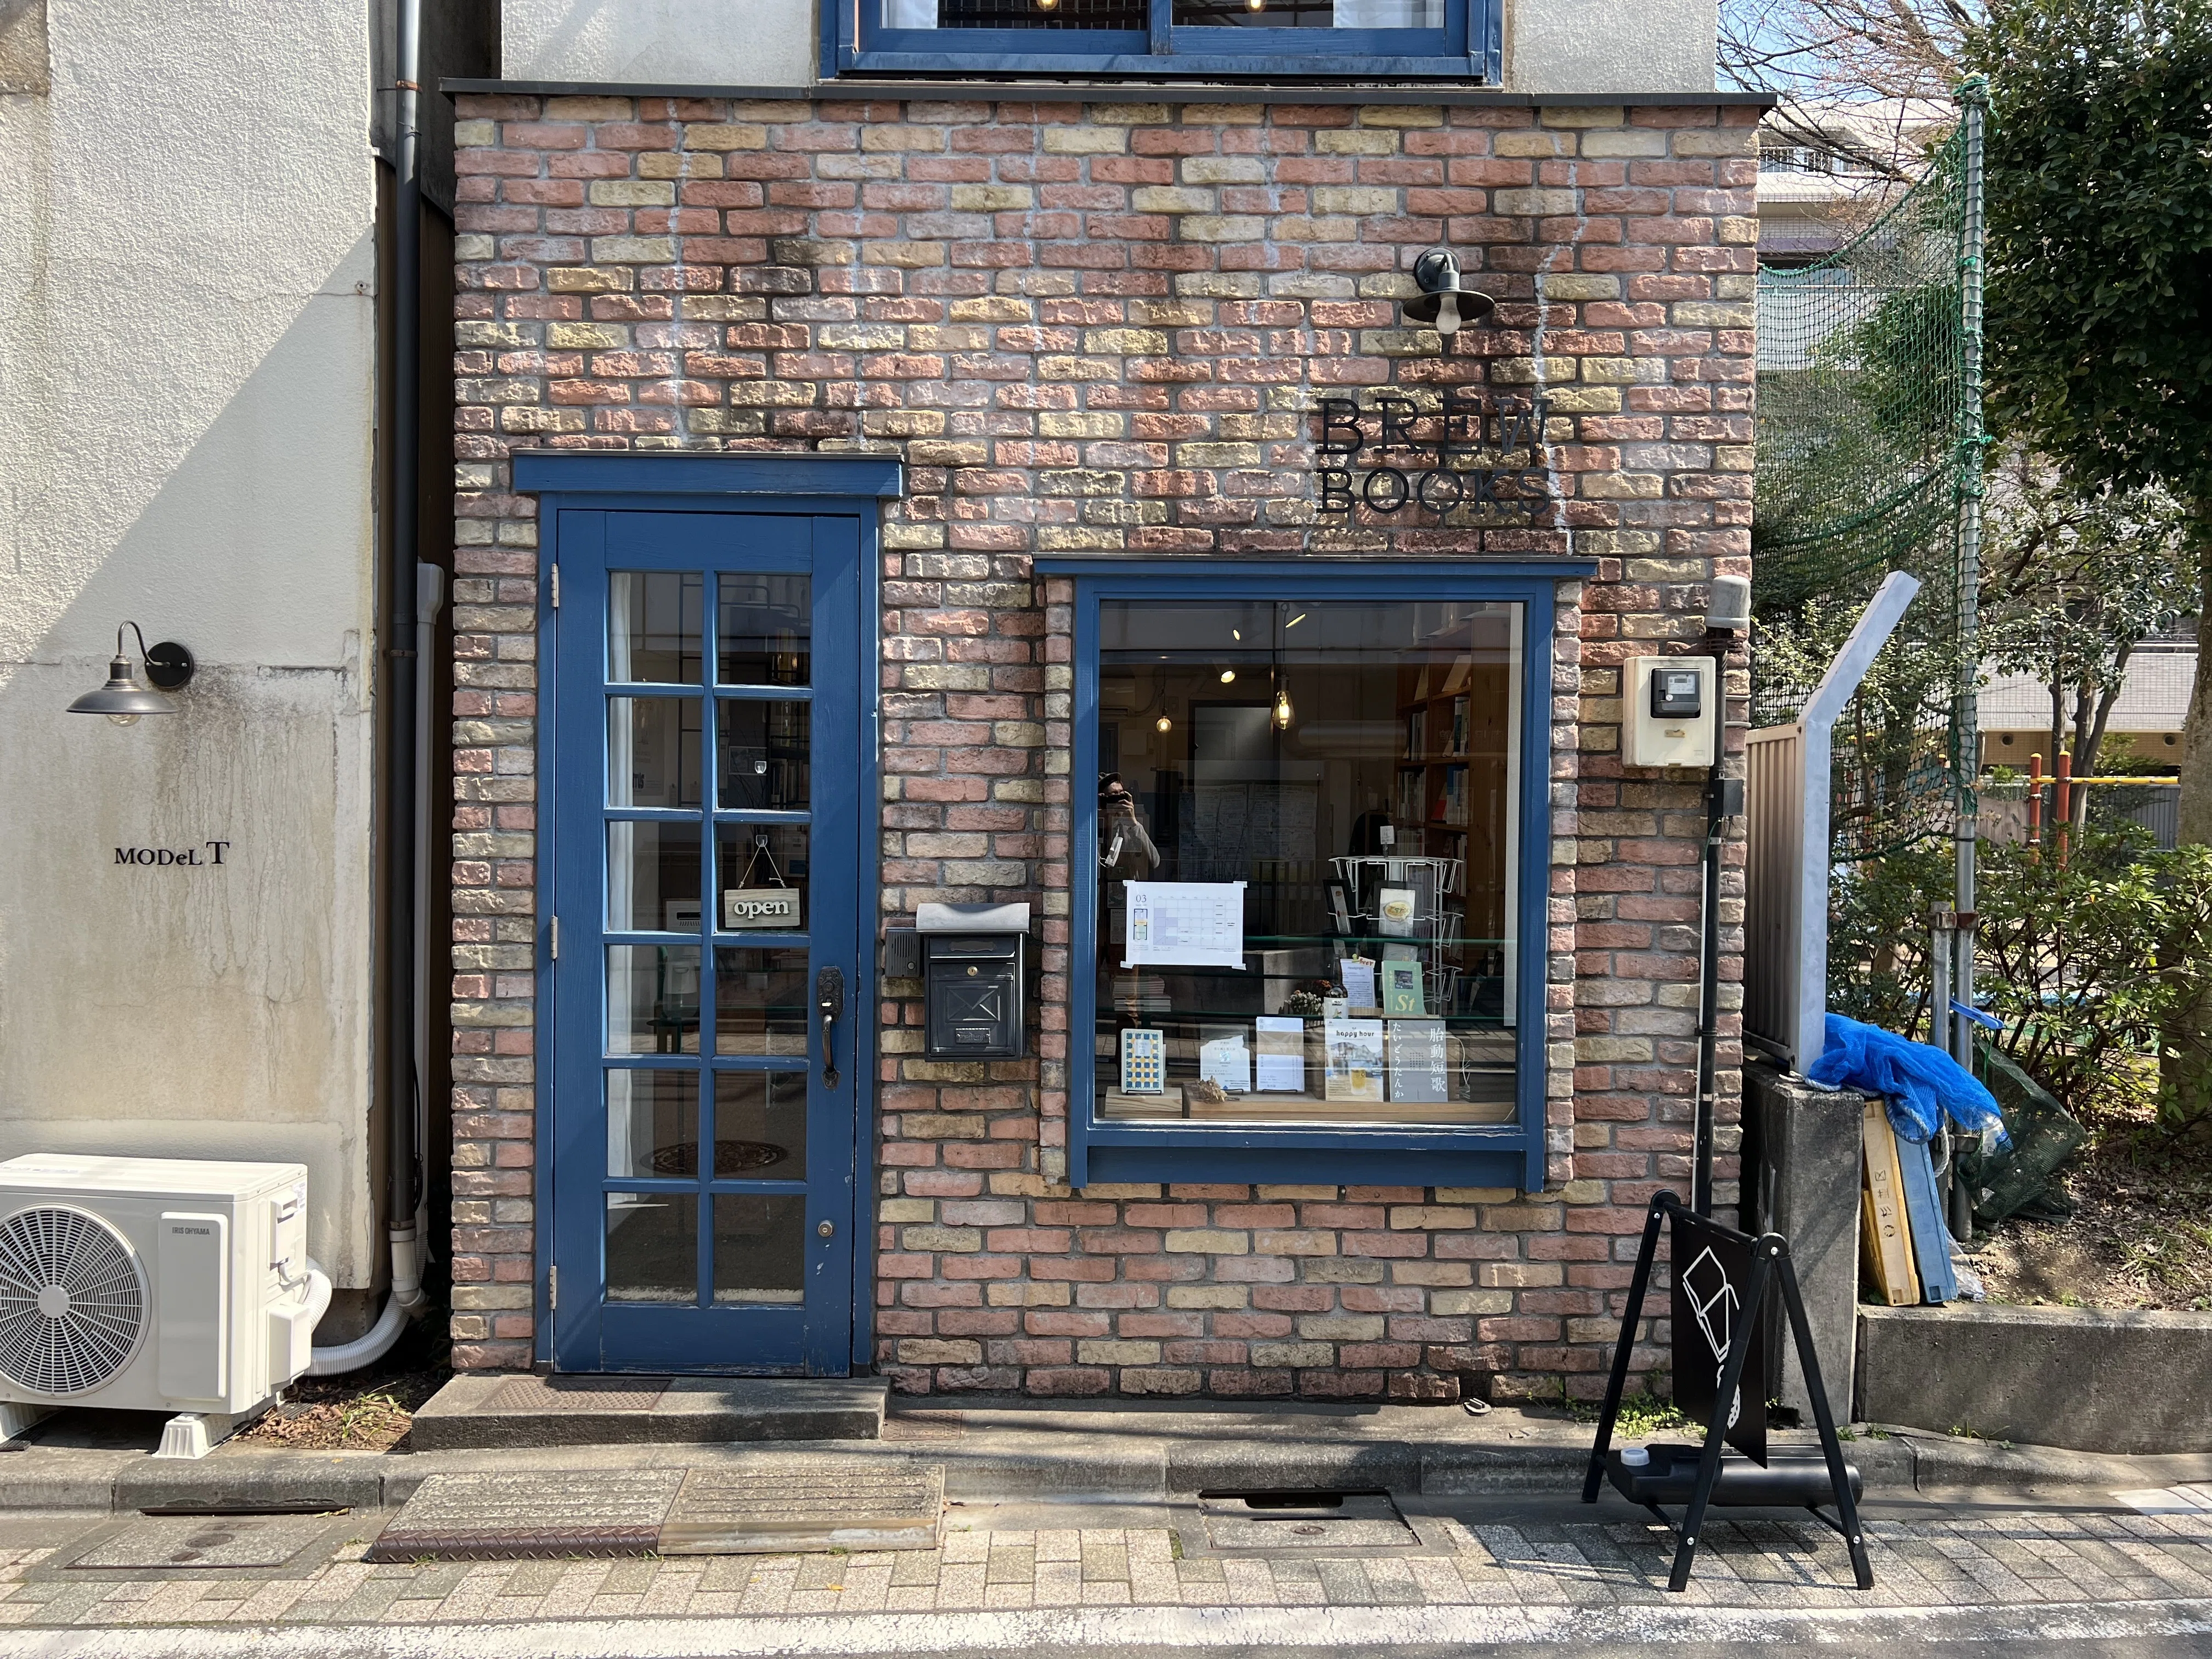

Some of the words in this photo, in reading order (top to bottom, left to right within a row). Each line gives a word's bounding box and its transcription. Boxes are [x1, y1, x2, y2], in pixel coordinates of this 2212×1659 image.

[1316, 398, 1554, 455] BREW
[1316, 467, 1551, 514] BOOKS
[206, 842, 230, 864] T
[1136, 894, 1147, 902] 03
[733, 900, 790, 919] open
[1395, 994, 1415, 1012] St
[1336, 1030, 1357, 1038] happy
[1392, 1022, 1404, 1098] たいどうたんか
[1429, 1027, 1447, 1092] 胎動短歌
